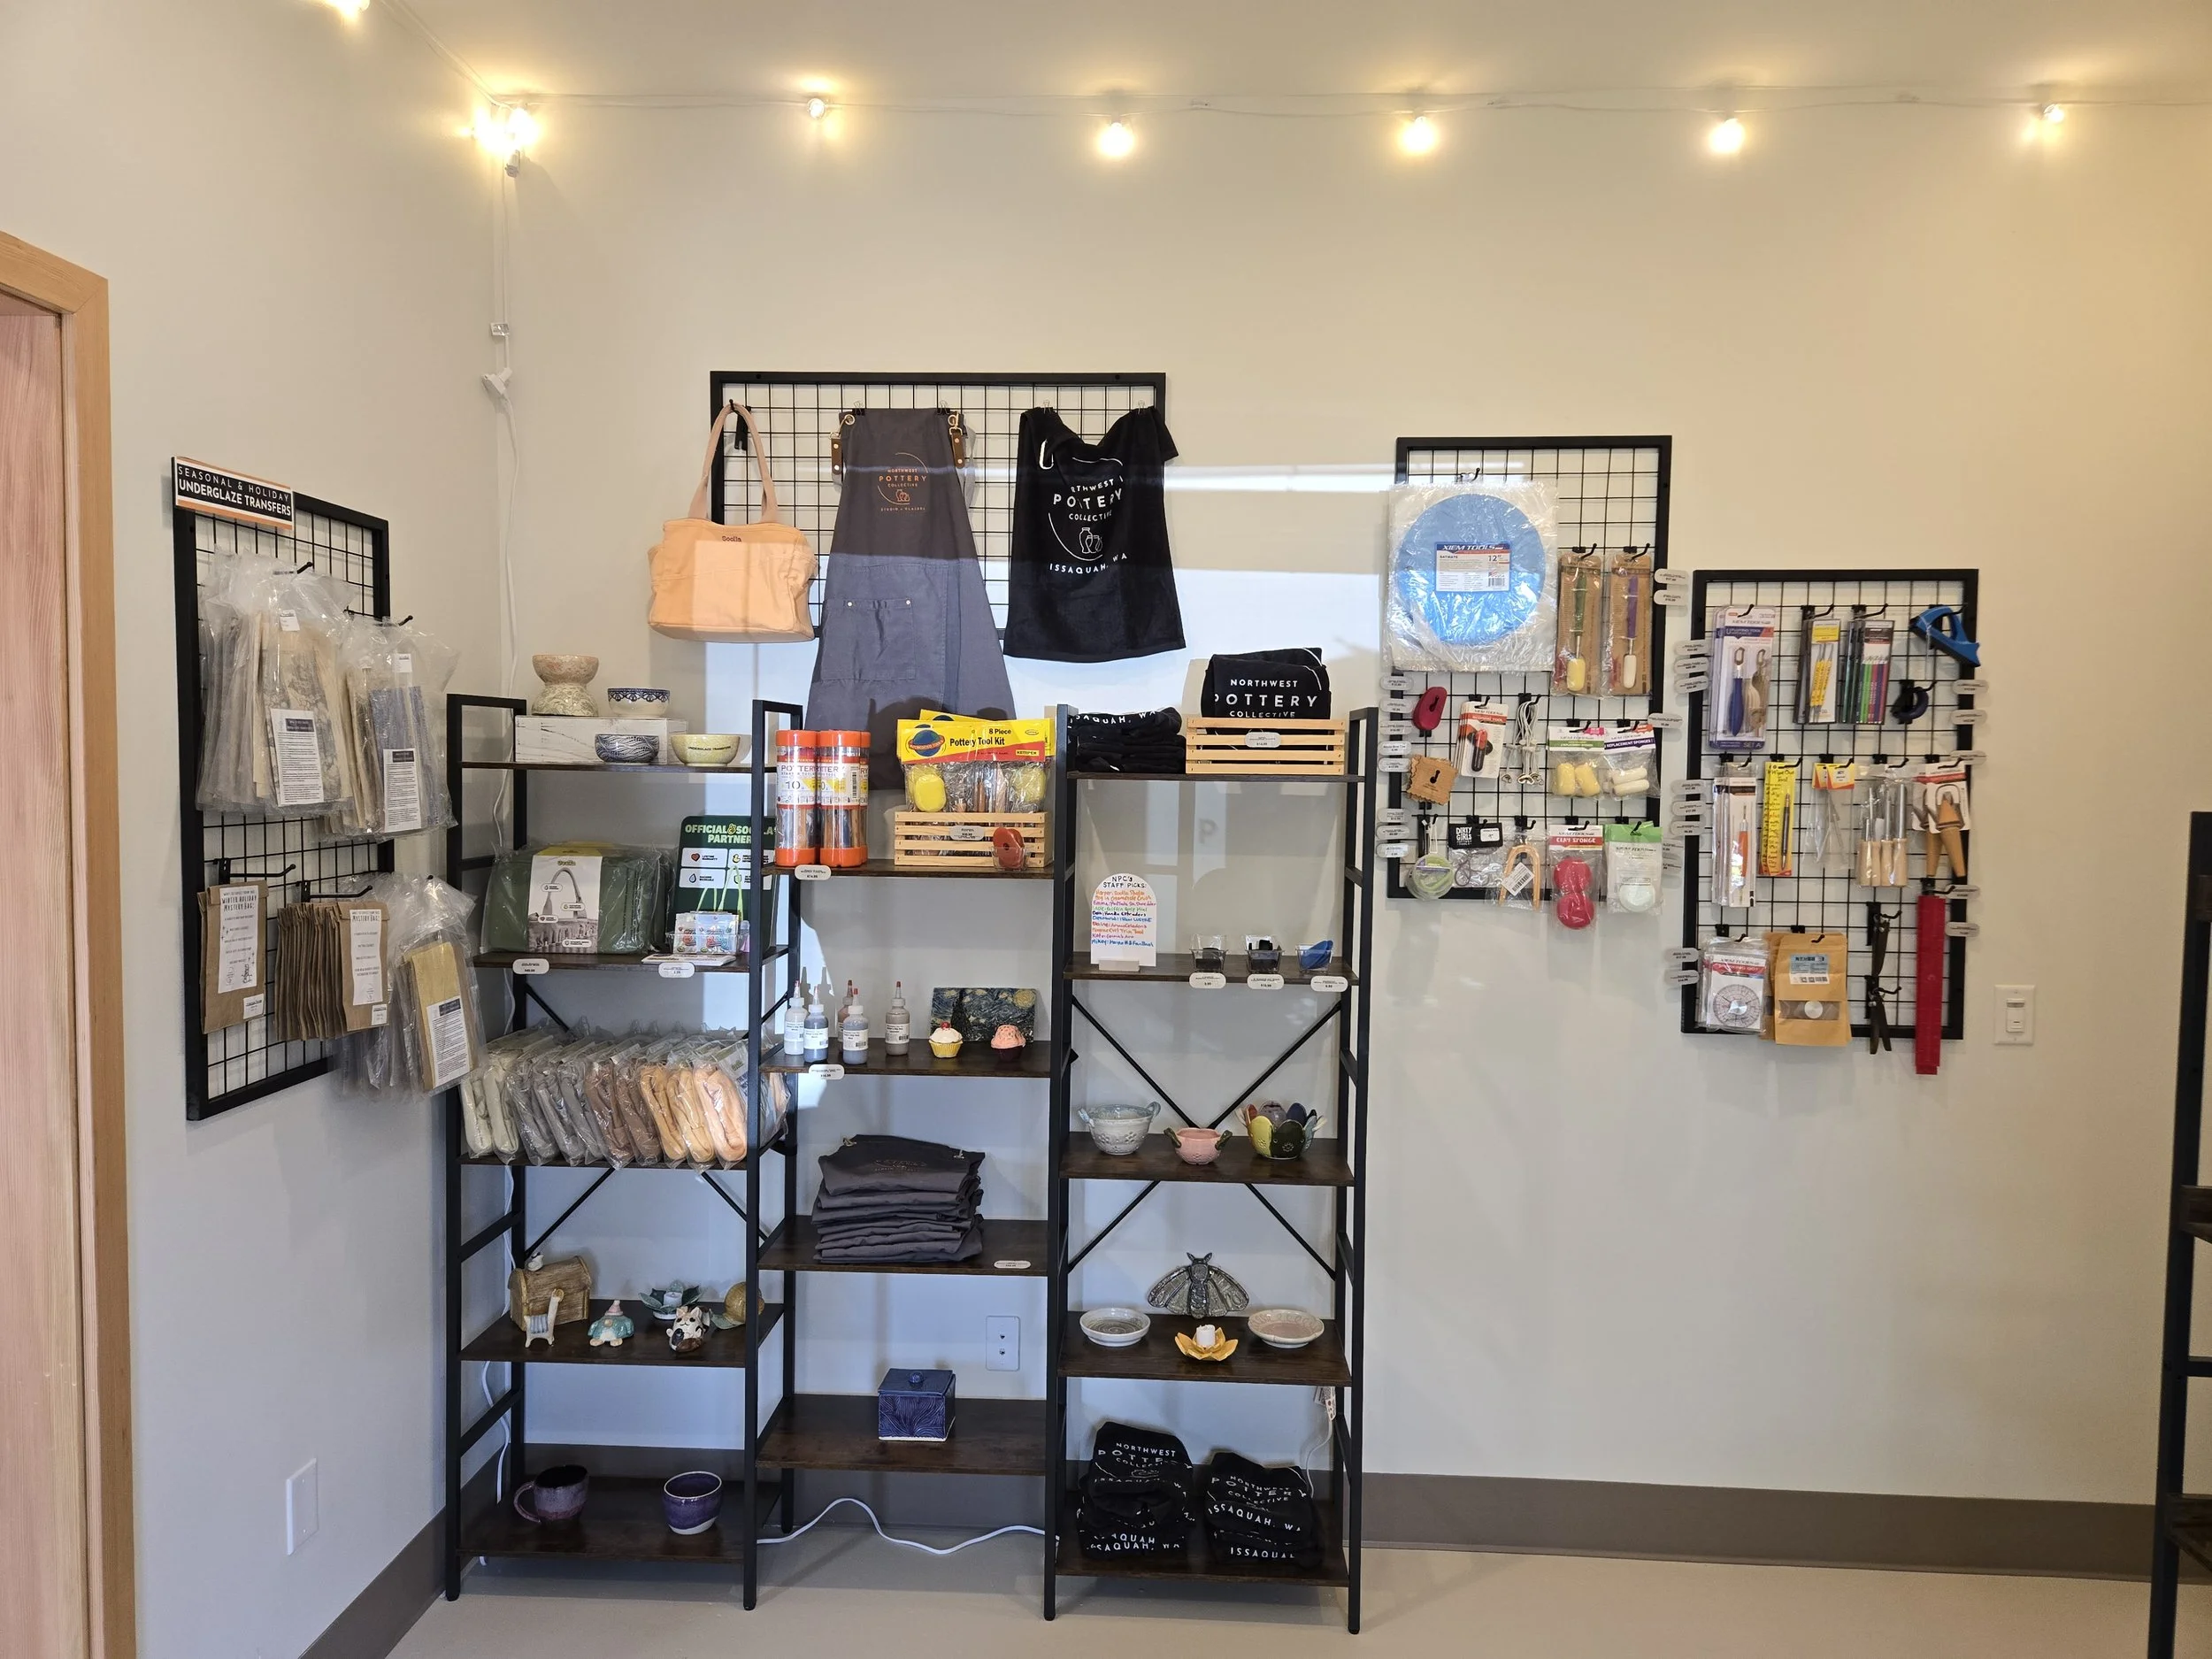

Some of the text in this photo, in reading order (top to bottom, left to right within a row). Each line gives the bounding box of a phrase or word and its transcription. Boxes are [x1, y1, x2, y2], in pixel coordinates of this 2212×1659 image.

[178, 465, 289, 502] SEASONAL & HOLIDAY
[179, 479, 291, 516] UNDERGLAZE TRANSFERS
[1053, 488, 1123, 511] POTERY
[1230, 679, 1299, 688] NORTHWEST
[978, 736, 993, 746] Tool
[995, 736, 1005, 746] Kit
[685, 824, 726, 834] OFFICIAL
[707, 834, 752, 844] PARTNER
[1116, 1442, 1176, 1457] NORTHWEST
